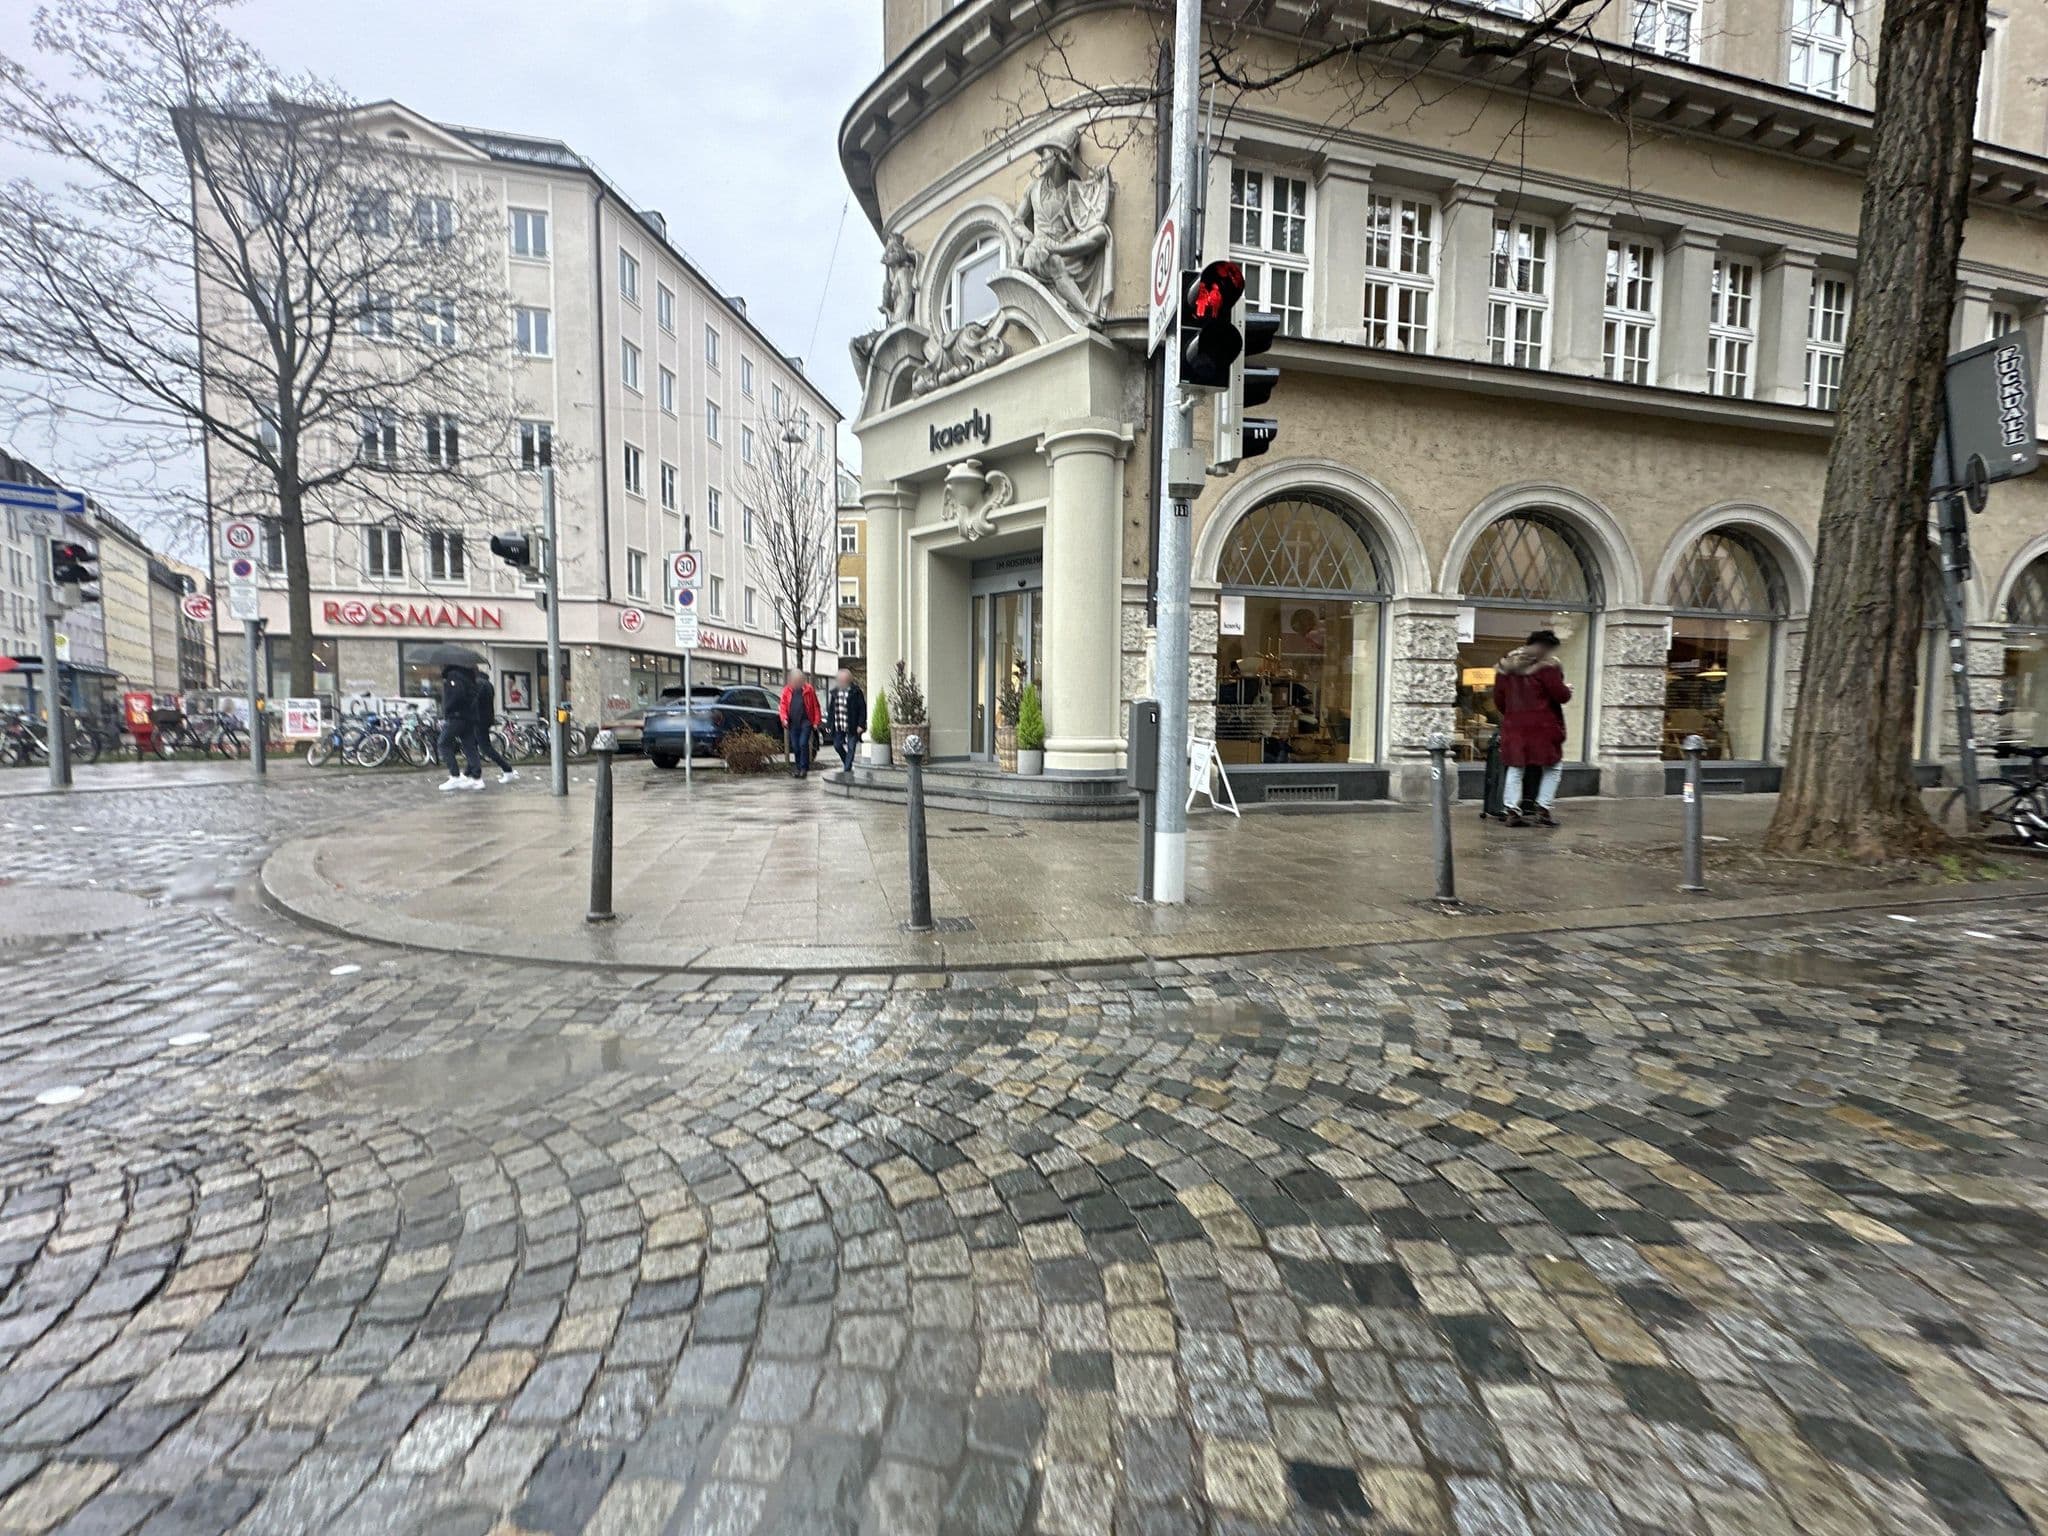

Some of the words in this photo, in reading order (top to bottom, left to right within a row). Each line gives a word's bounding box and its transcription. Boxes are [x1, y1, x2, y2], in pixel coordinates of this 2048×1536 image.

[1158, 239, 1170, 289] 30
[929, 407, 991, 453] kaerly
[232, 529, 249, 542] 30
[679, 560, 692, 572] 30
[323, 601, 503, 629] ROSSMANN
[697, 628, 748, 656] OSSMANN
